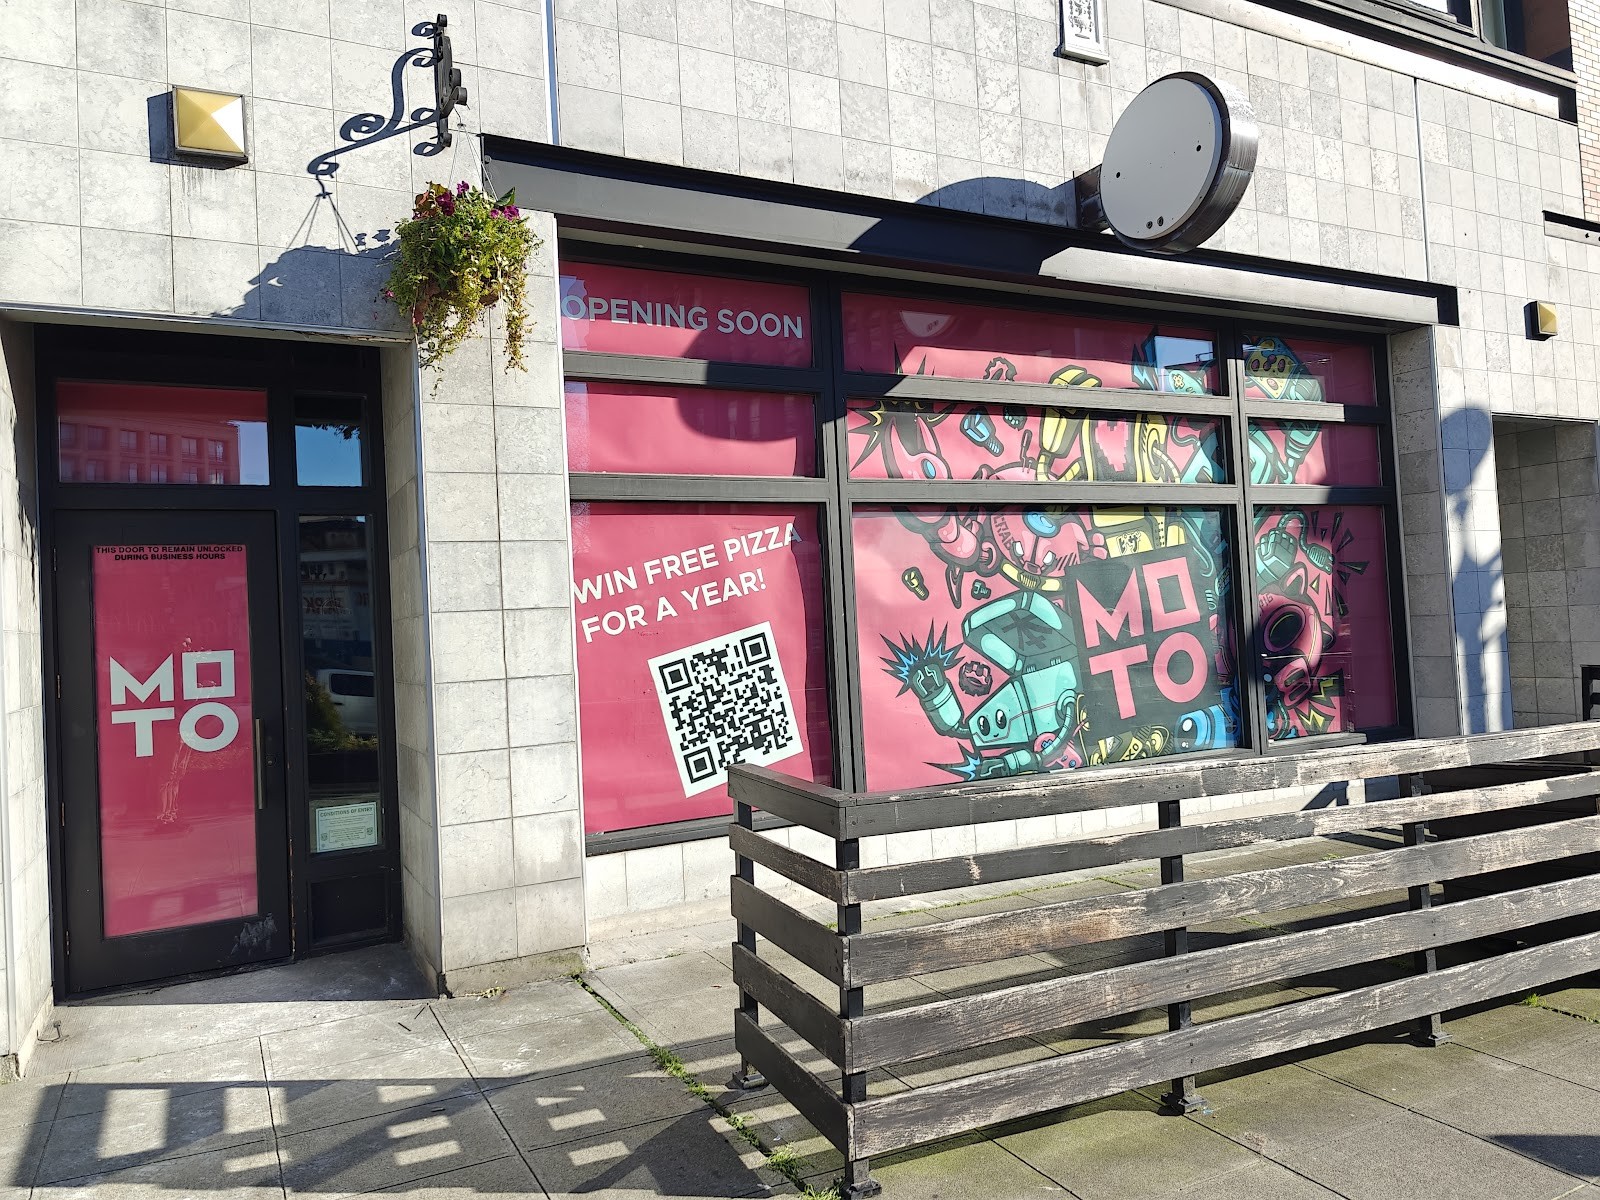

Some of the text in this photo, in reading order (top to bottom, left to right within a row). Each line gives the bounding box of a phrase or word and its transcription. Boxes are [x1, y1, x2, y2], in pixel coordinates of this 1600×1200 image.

[561, 295, 803, 339] OPENING SOON
[162, 545, 195, 553] REMAIN
[198, 545, 243, 553] UNLOCKED
[574, 522, 803, 604] WIN FREE PIZZA
[581, 568, 767, 643] FOR A YEAR!
[320, 809, 350, 817] CONDITIONS
